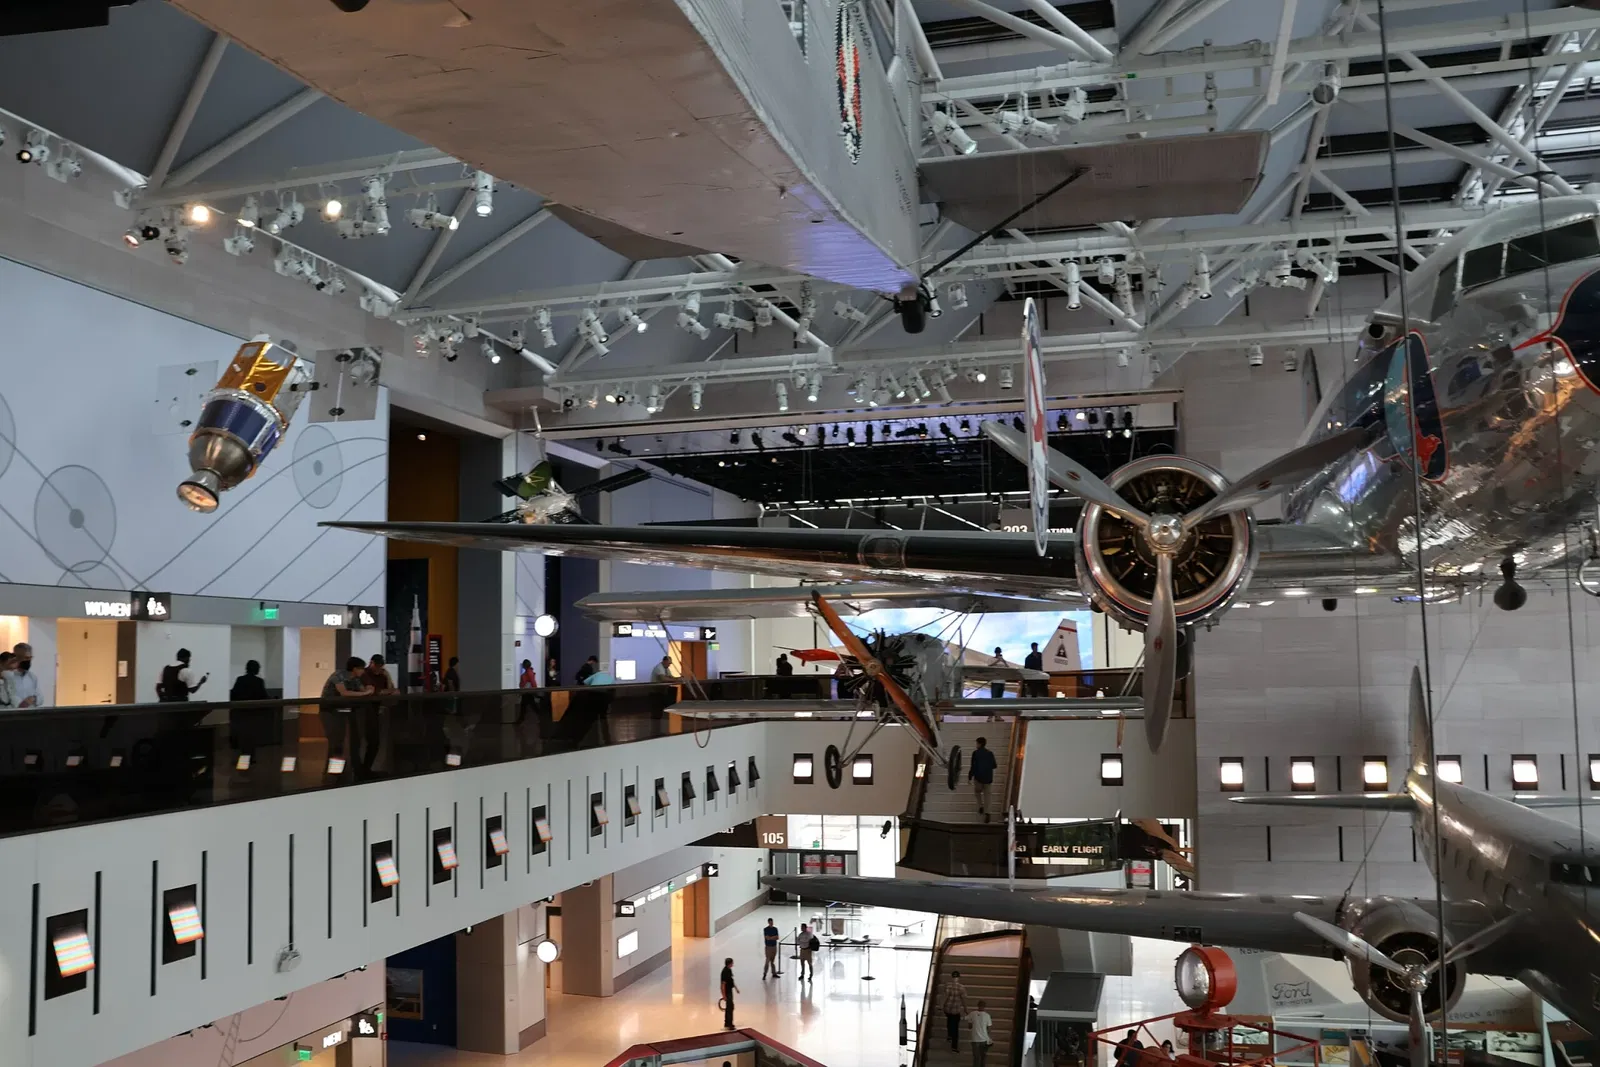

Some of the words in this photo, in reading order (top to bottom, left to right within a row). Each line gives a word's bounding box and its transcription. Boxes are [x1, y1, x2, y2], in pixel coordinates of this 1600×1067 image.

[1003, 525, 1028, 533] 203
[84, 601, 131, 617] WOMEN
[323, 614, 342, 626] MEN
[762, 832, 784, 844] 105
[1042, 845, 1068, 854] EARLY
[1072, 845, 1104, 854] FLIGHT
[1272, 981, 1312, 999] Ford
[323, 1031, 342, 1048] MEN
